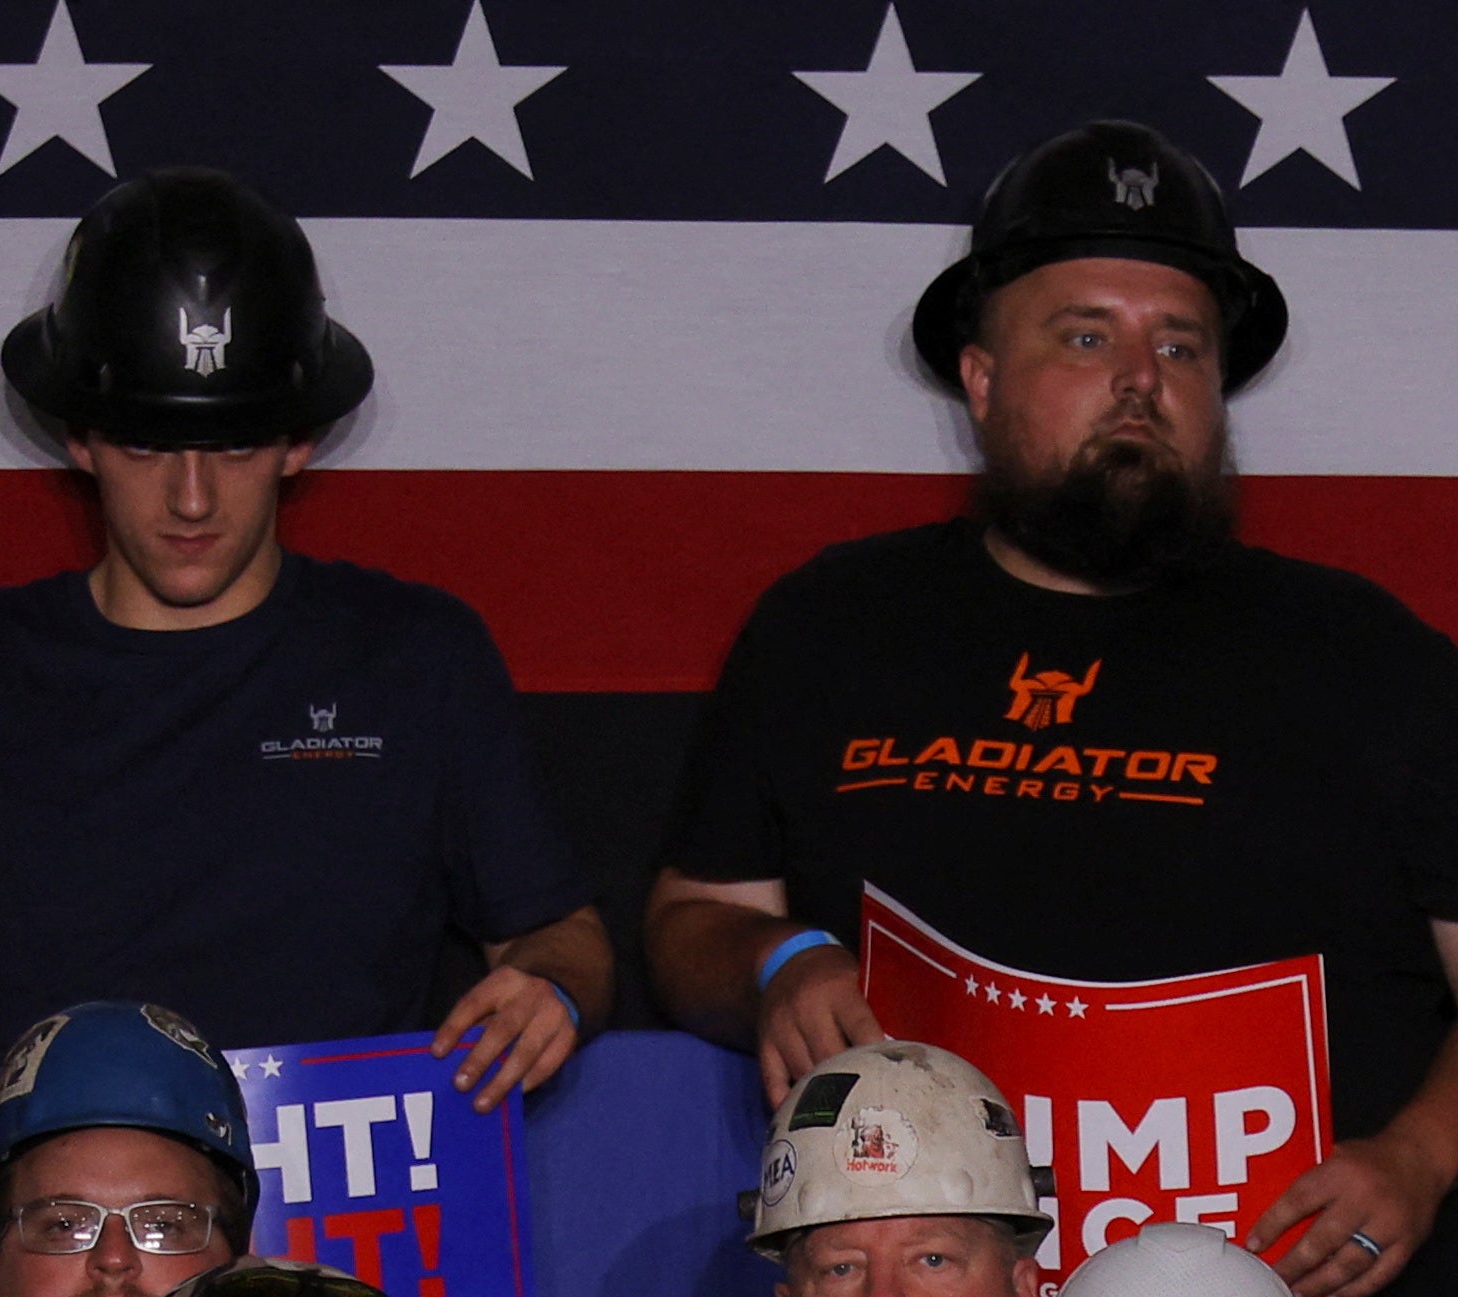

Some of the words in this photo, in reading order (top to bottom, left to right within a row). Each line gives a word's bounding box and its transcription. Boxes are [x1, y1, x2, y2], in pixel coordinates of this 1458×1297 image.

[261, 737, 384, 753] GLADIATOR
[841, 738, 1217, 786] GLADIATOR
[915, 771, 1118, 803] ENERGY
[846, 1157, 899, 1174] Hotwork
